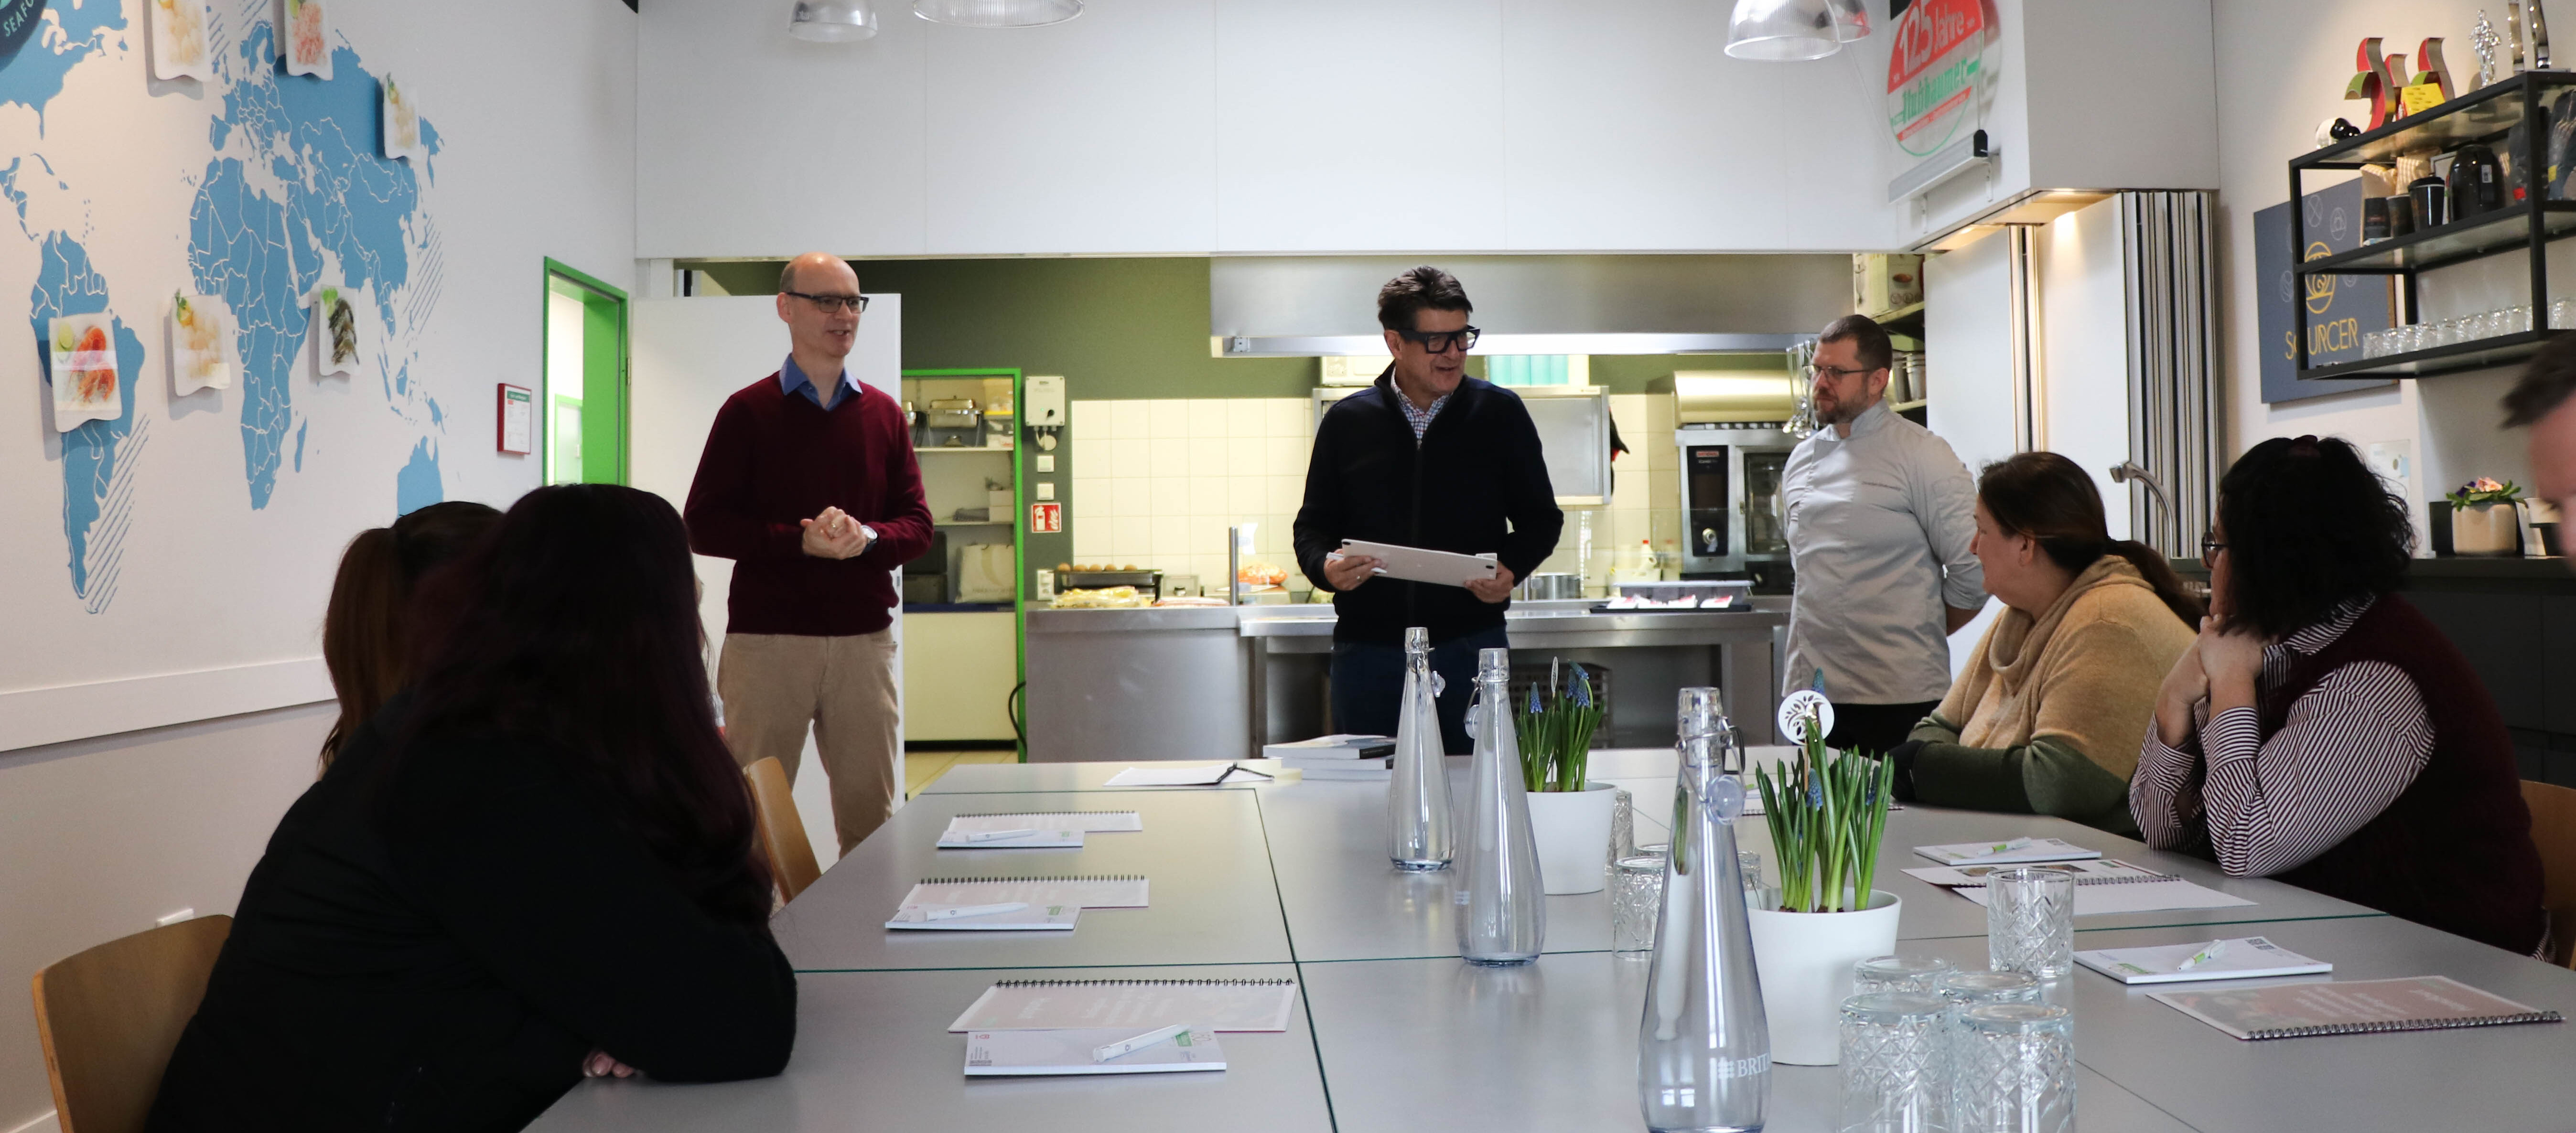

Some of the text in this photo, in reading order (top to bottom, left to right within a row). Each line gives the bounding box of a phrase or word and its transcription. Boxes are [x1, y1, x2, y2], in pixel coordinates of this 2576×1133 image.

[1899, 0, 1964, 75] 125 Jahre
[2285, 317, 2359, 360] SURCER
